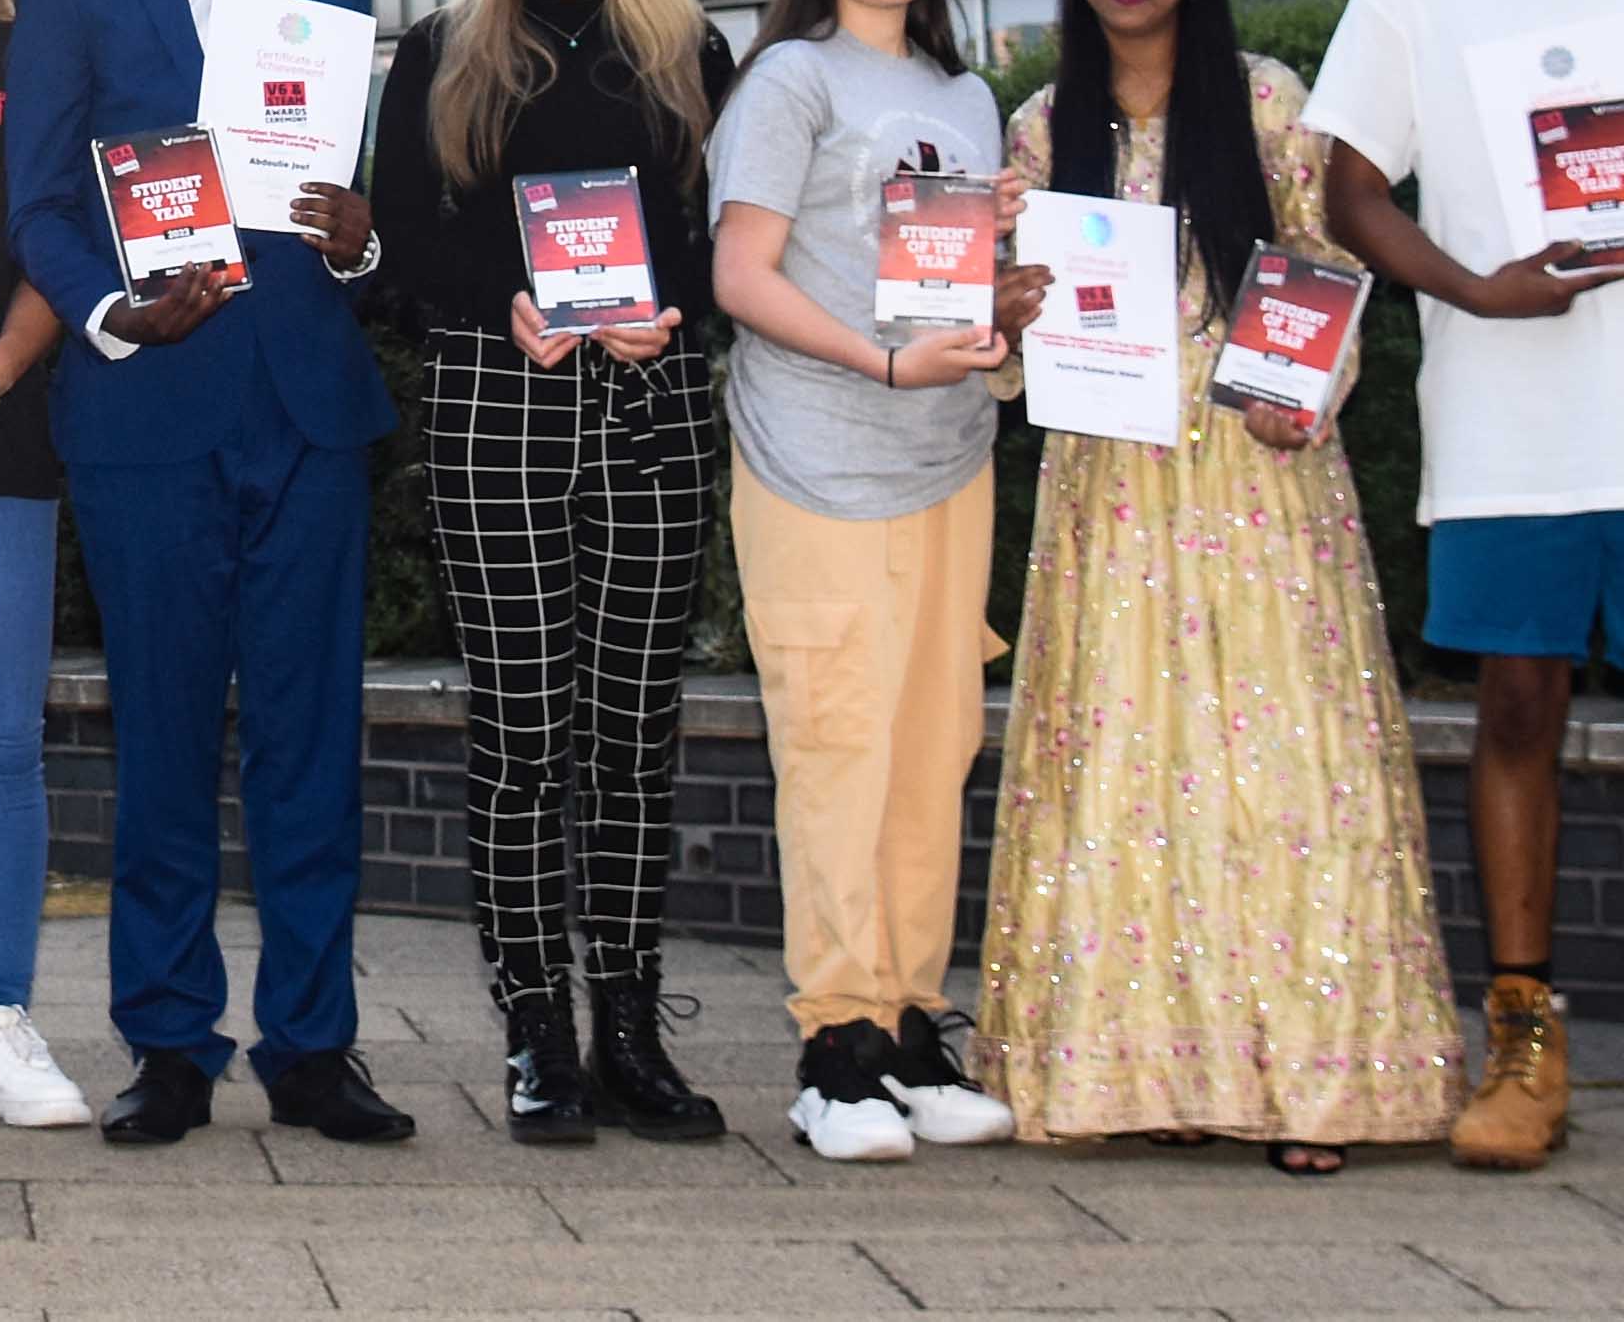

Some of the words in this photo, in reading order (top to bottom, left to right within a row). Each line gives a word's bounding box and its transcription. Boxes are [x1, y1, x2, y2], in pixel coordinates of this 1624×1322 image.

[267, 84, 287, 96] V6
[292, 83, 301, 95] &
[265, 108, 307, 116] AWARDS
[249, 158, 289, 169] Abdoulie
[1566, 165, 1588, 180] OF
[130, 174, 203, 198] STUDENT
[1579, 177, 1623, 194] YEAR
[141, 194, 164, 209] OF
[166, 188, 199, 205] THE
[152, 203, 194, 222] YEAR
[545, 216, 619, 233] STUDENT
[555, 232, 578, 245] OF
[581, 229, 613, 243] THE
[898, 224, 974, 241] STUDENT
[565, 243, 607, 257] YEAR
[905, 240, 929, 253] OF
[932, 241, 966, 255] THE
[913, 254, 957, 269] YEAR
